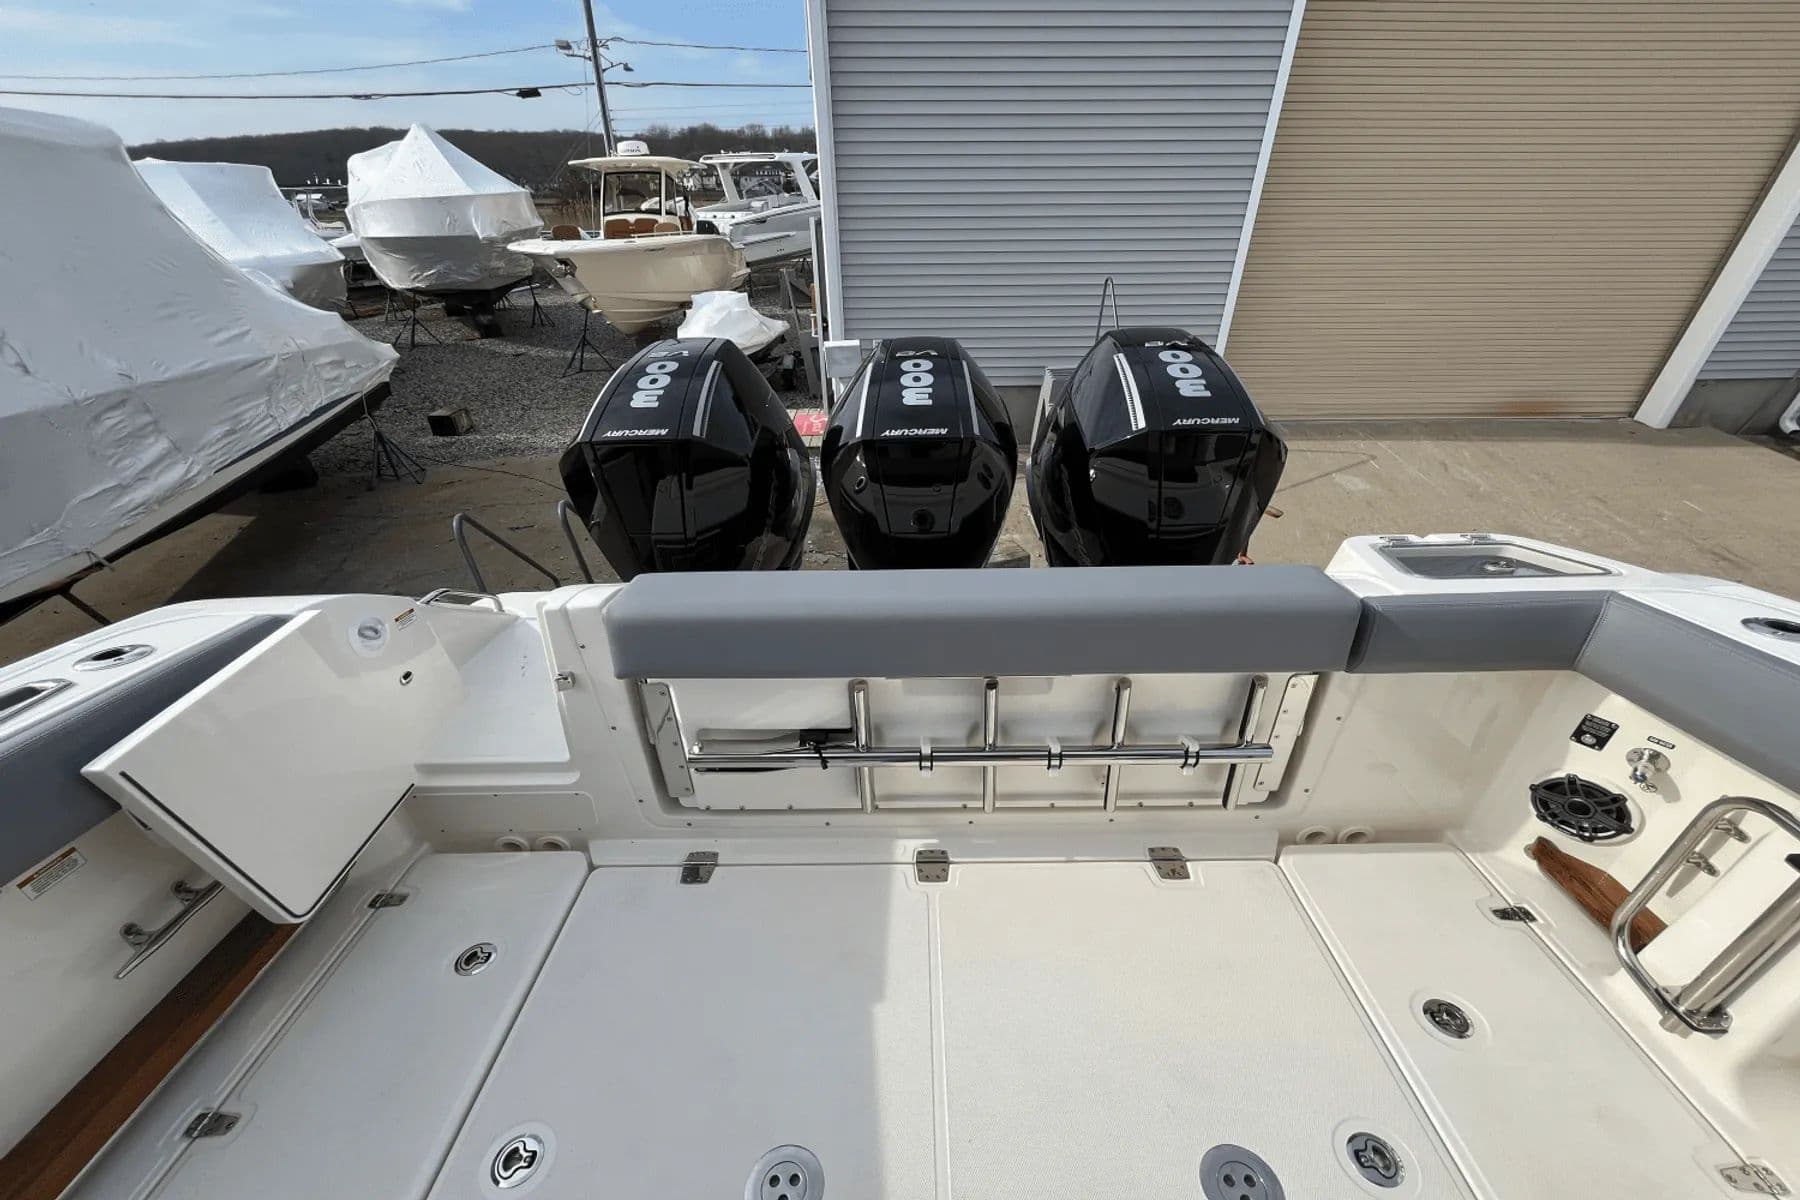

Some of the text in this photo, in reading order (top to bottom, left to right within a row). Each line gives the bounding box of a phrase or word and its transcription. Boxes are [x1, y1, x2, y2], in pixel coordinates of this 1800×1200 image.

[630, 361, 680, 408] 300
[900, 359, 934, 406] 300
[1158, 350, 1212, 397] 300
[602, 428, 669, 437] MERCURY
[880, 428, 948, 437] MERCURY
[1172, 417, 1240, 425] MERCURY
